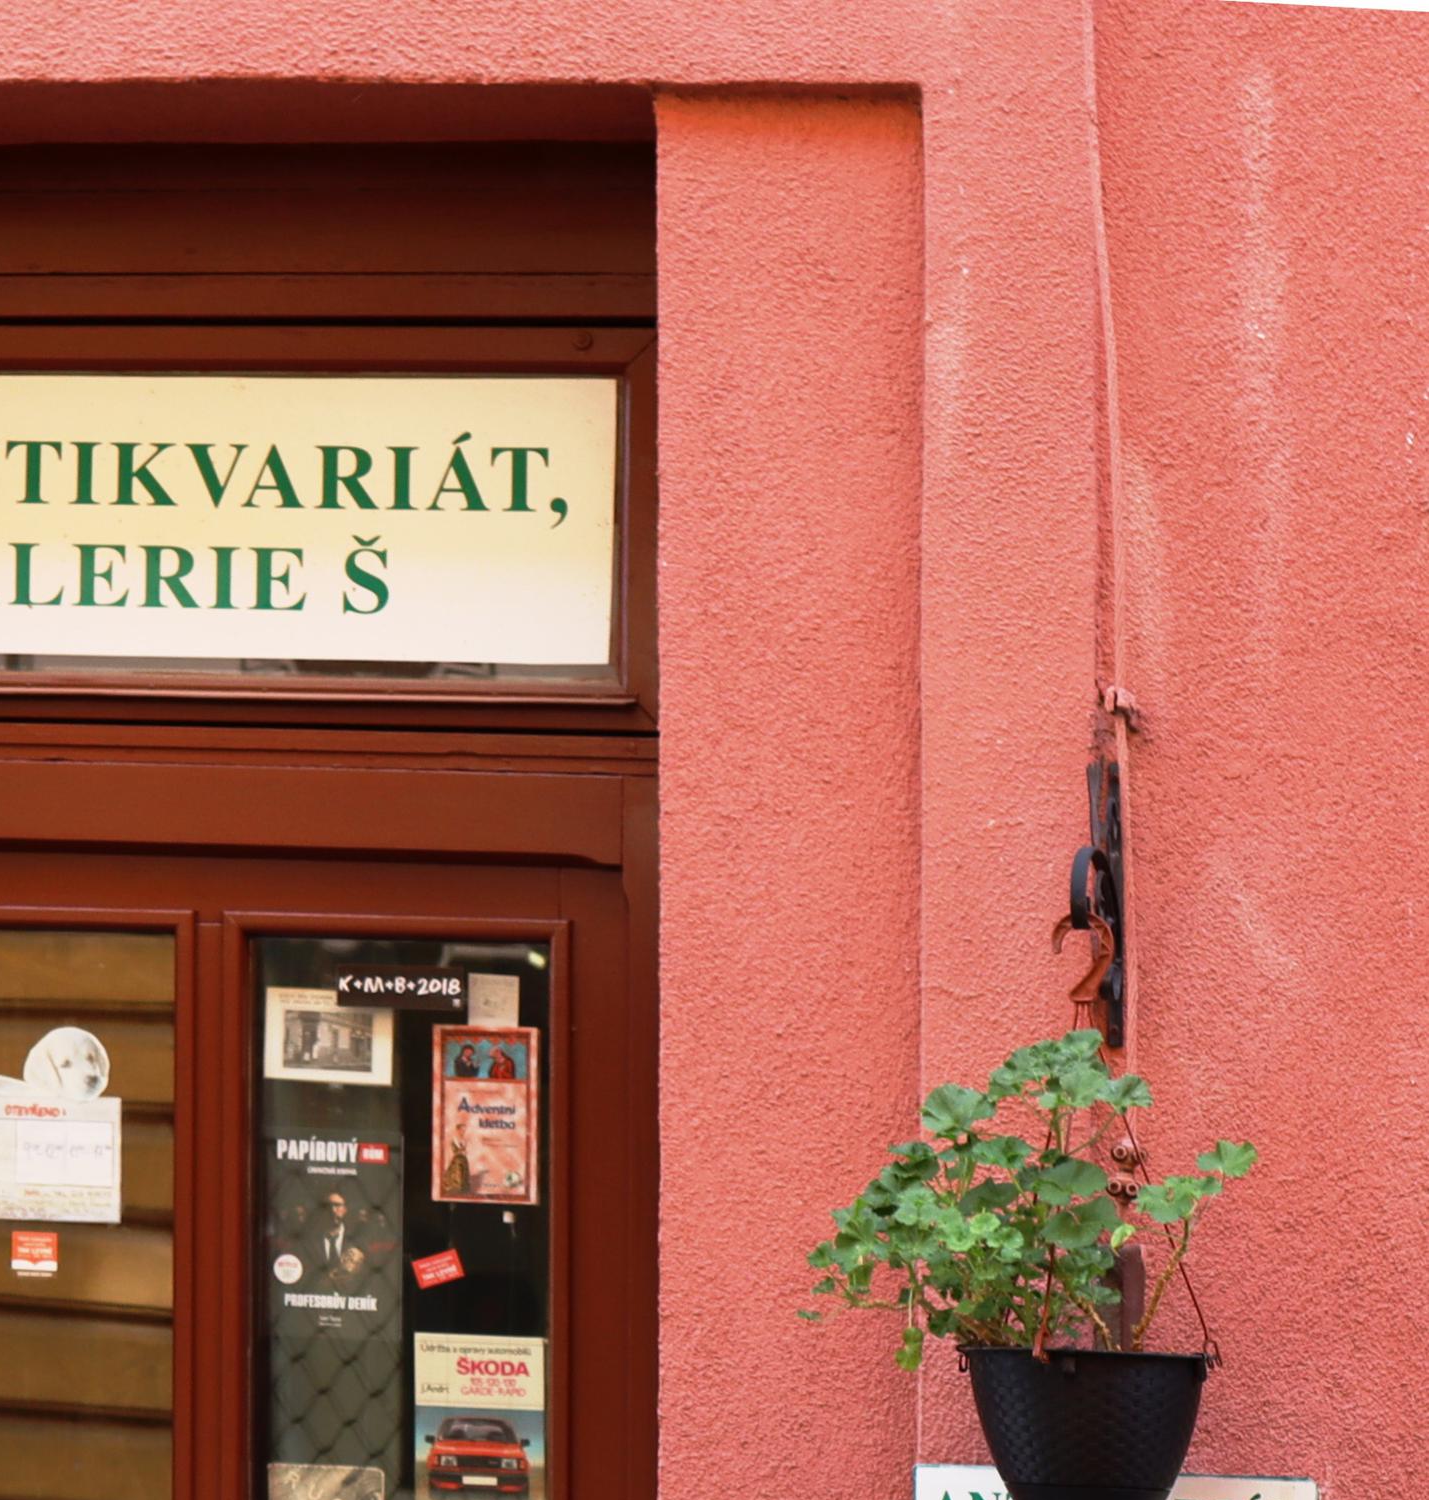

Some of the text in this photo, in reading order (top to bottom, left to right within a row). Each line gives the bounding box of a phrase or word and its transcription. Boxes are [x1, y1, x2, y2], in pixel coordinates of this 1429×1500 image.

[341, 535, 390, 615] Š
[276, 1135, 358, 1163] PAPÍROVÝ
[456, 1356, 530, 1377] ŠKODA
